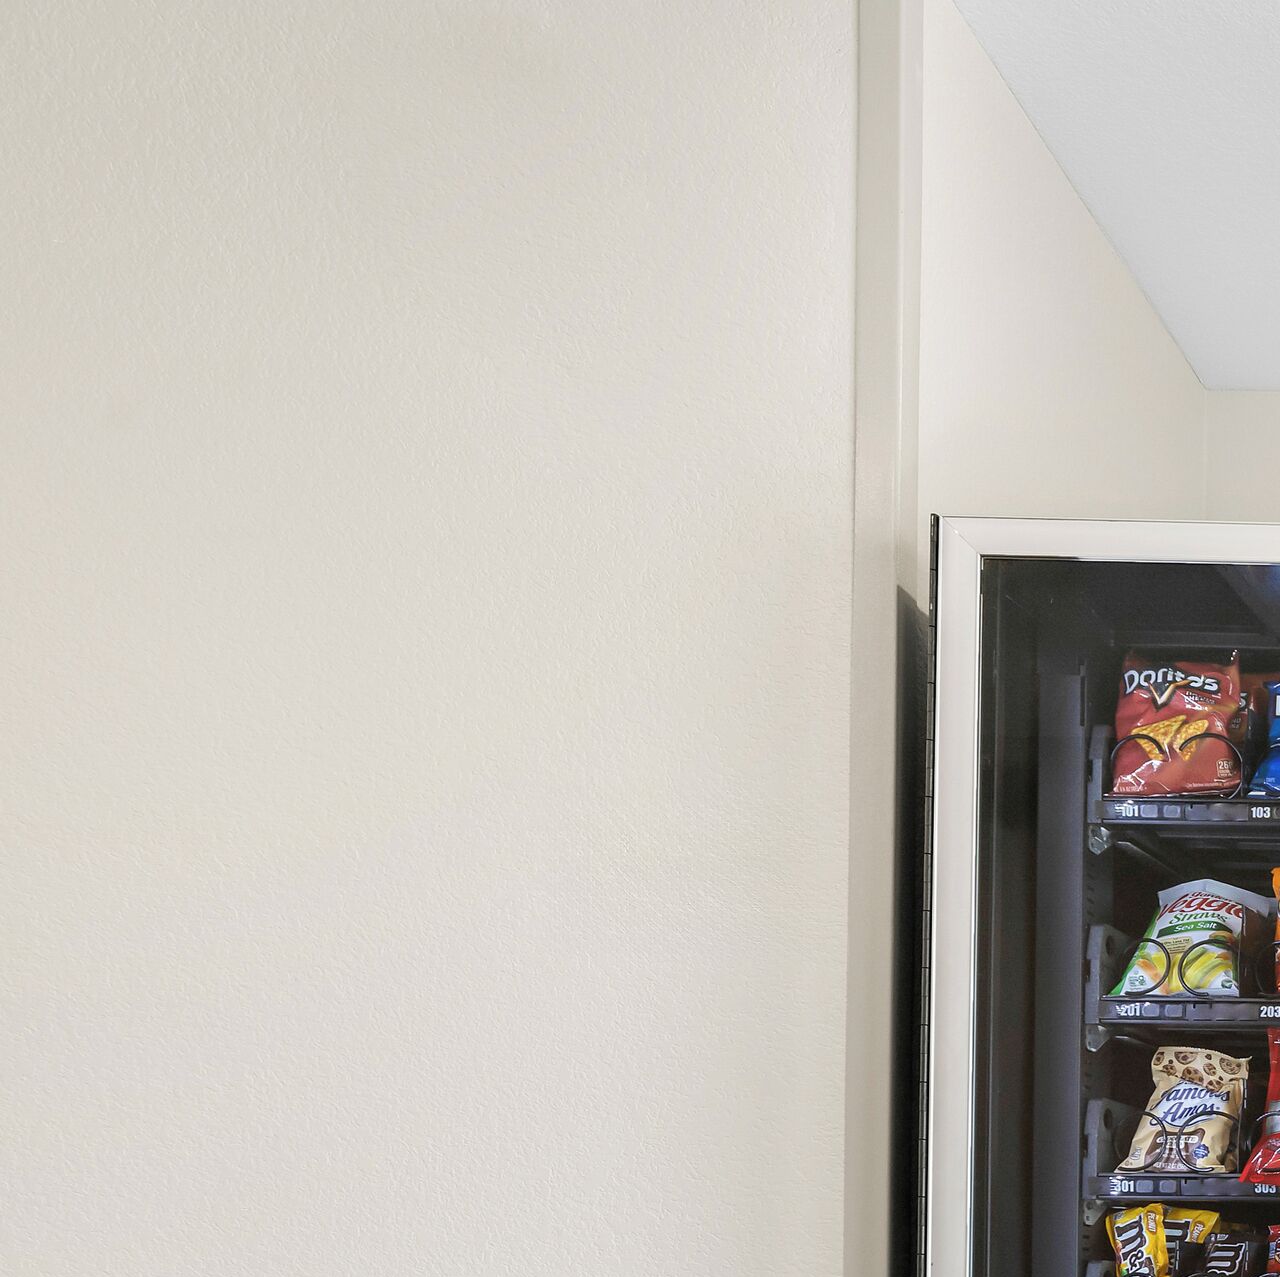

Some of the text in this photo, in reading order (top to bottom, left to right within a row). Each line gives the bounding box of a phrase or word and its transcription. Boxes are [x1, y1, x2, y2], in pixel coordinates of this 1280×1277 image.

[1124, 667, 1219, 695] Doritos
[1251, 807, 1271, 818] 103
[1169, 913, 1229, 925] Straws
[1174, 924, 1194, 932] Sea
[1161, 1102, 1215, 1122] Amos
[1116, 1180, 1134, 1193] 301
[1255, 1183, 1277, 1194] 303
